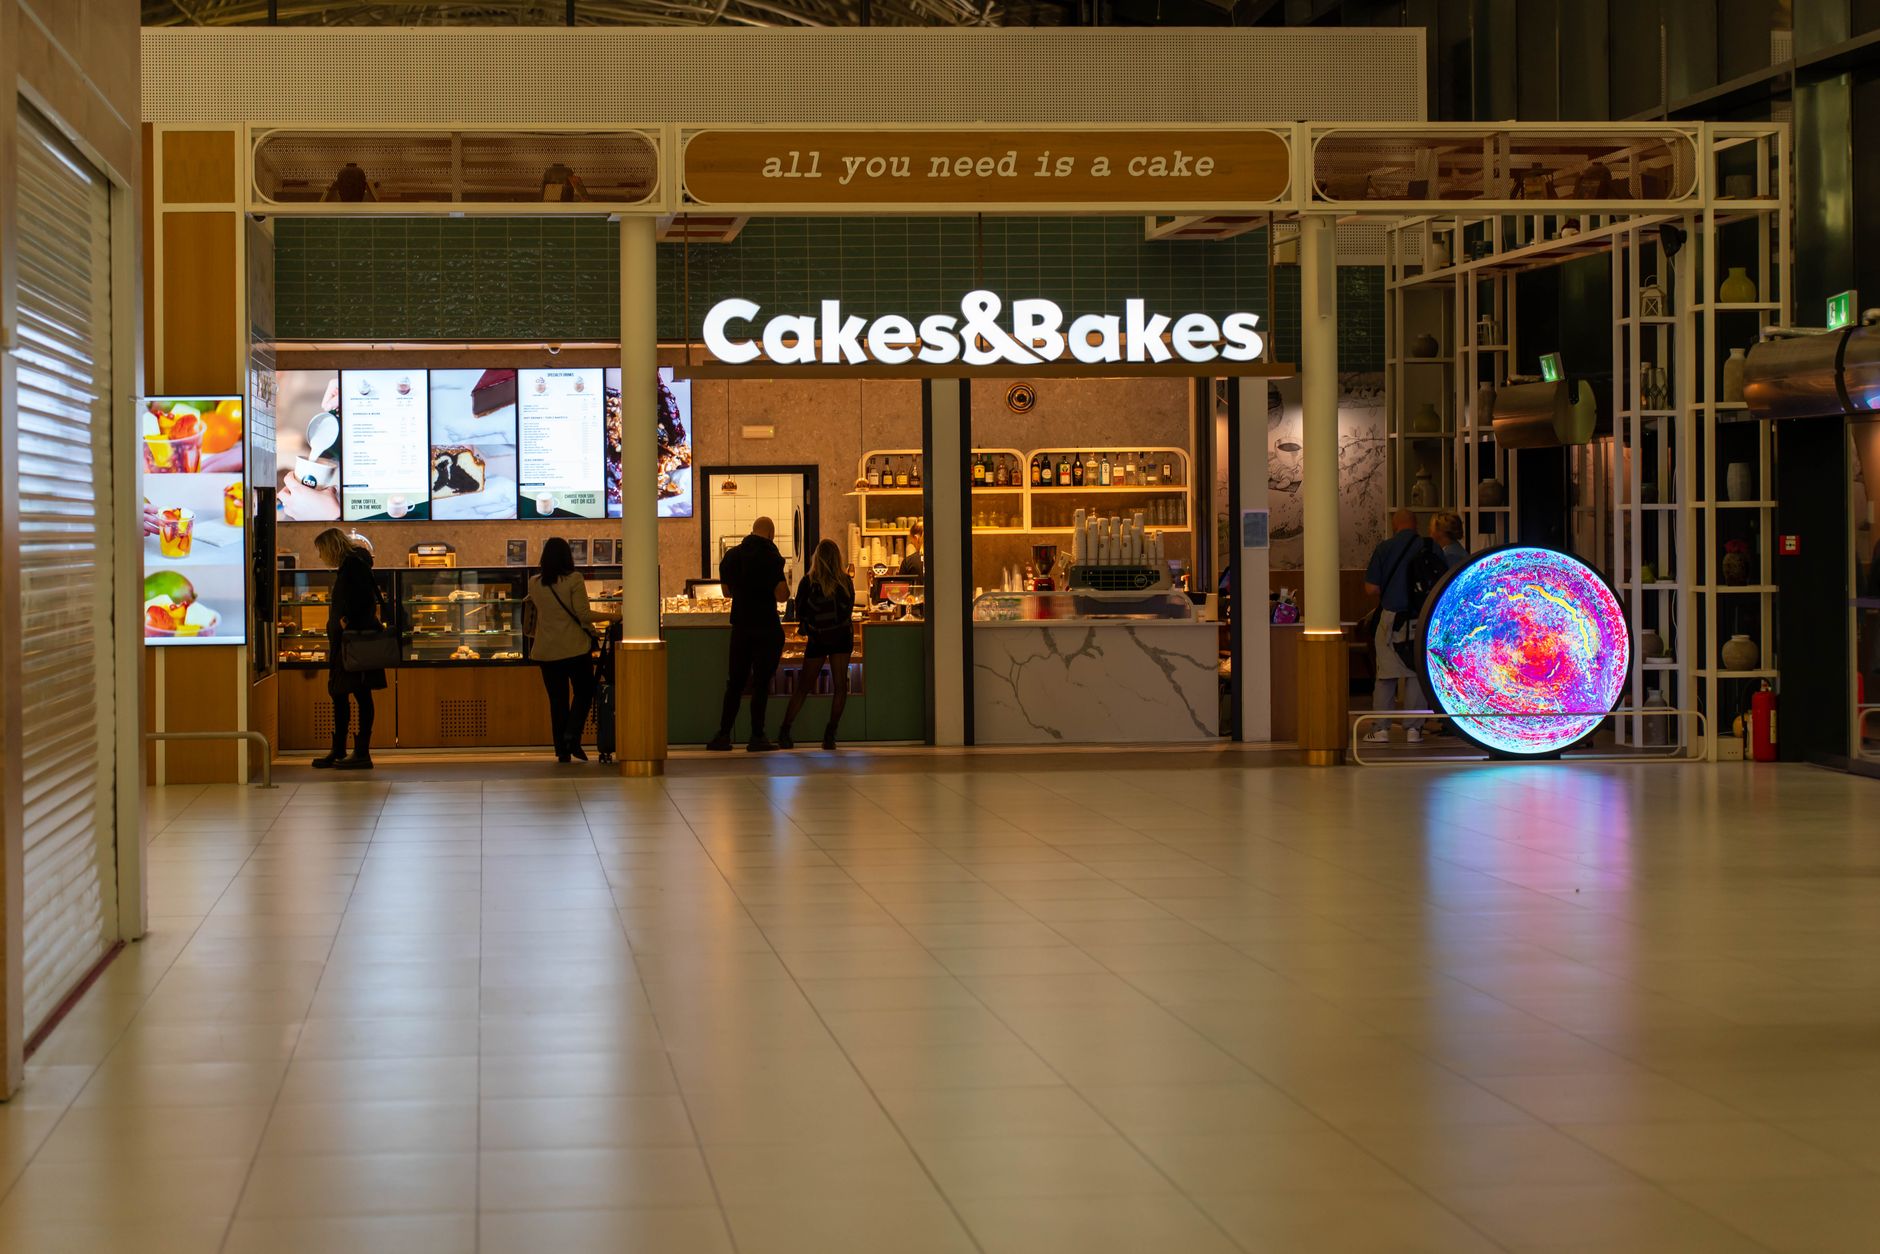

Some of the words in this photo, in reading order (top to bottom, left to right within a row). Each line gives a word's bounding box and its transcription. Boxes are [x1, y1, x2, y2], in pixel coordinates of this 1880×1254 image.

[762, 150, 822, 178] all
[838, 156, 910, 185] you
[927, 150, 1018, 178] need
[1034, 150, 1075, 178] is
[1090, 156, 1111, 178] a
[1127, 150, 1215, 178] cake
[702, 289, 1266, 366] Cakes&Bakes
